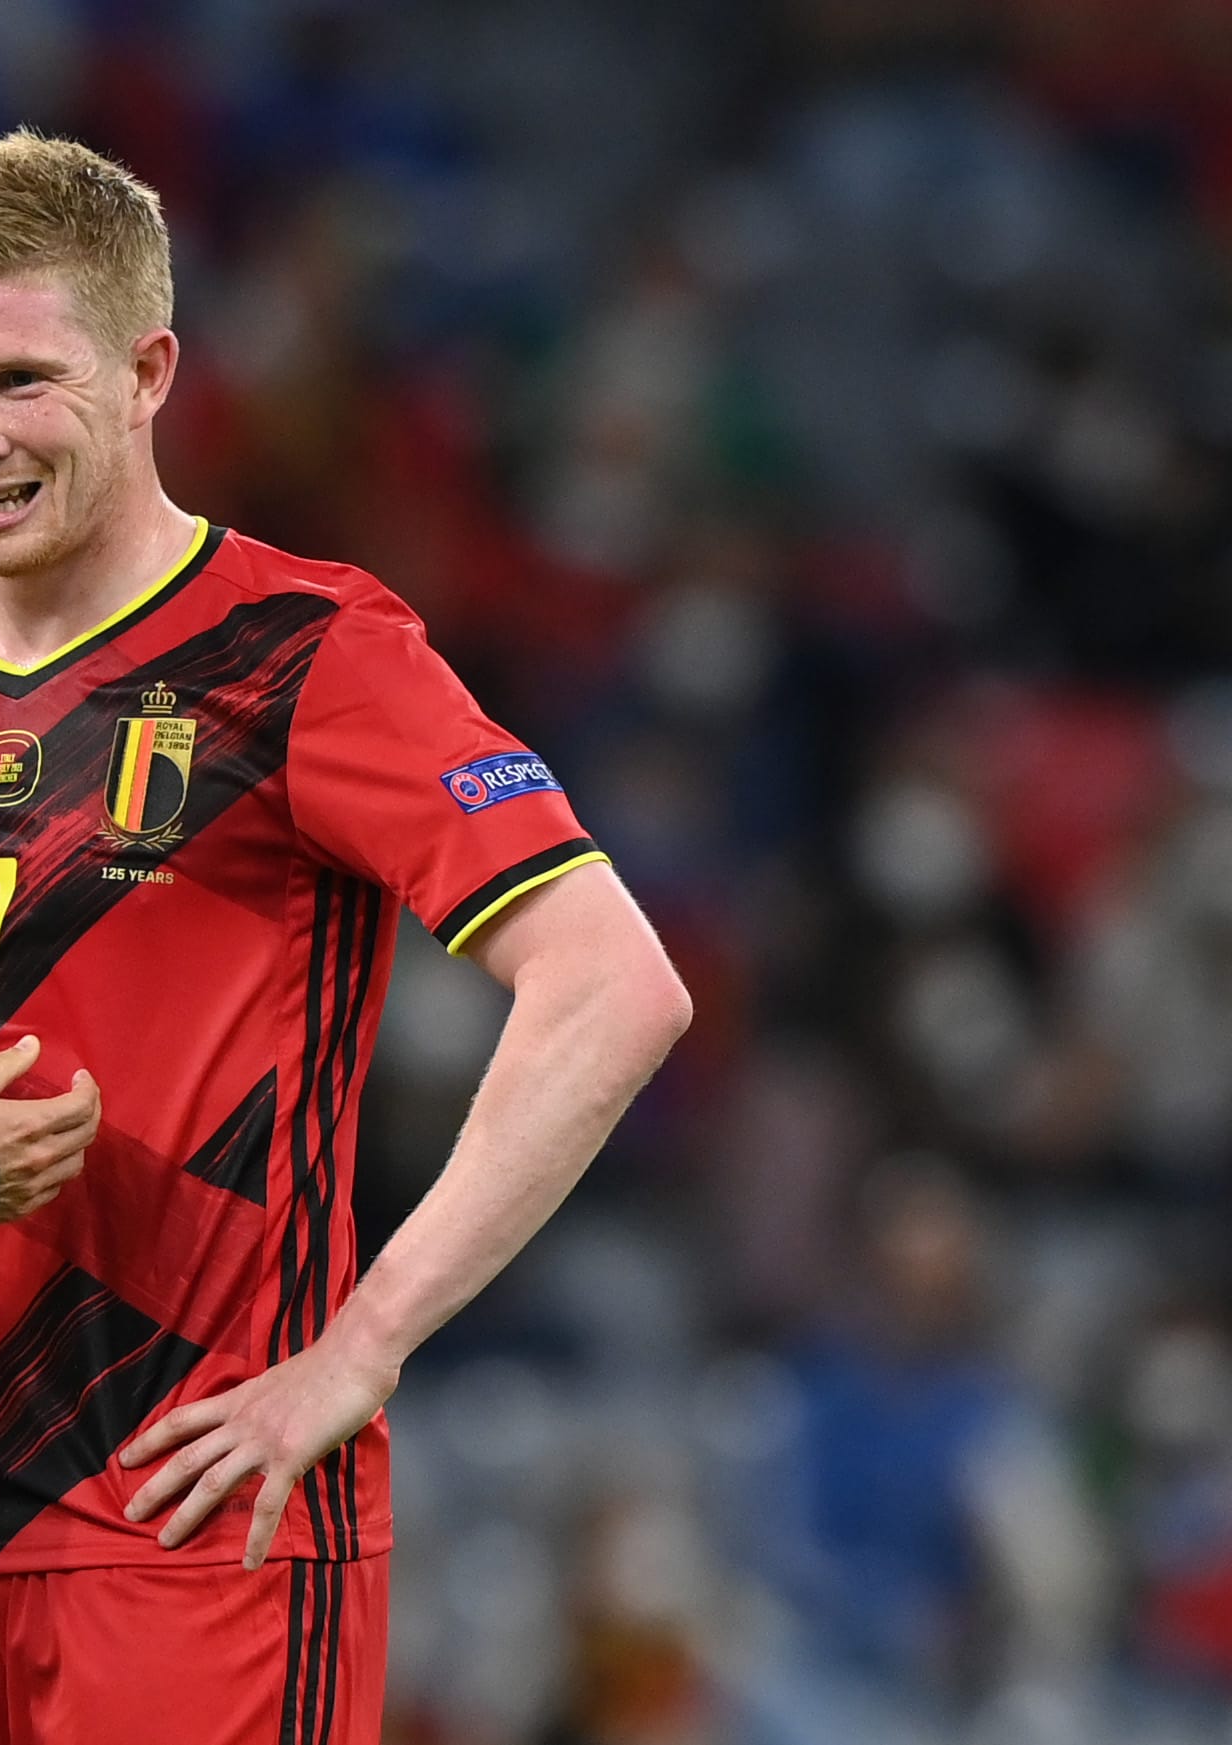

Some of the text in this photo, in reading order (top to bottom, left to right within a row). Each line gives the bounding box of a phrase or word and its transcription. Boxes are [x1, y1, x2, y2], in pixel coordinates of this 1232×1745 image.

[156, 721, 183, 731] ROYAL
[154, 731, 193, 741] BELGIAN
[101, 867, 175, 885] 125 YEARS
